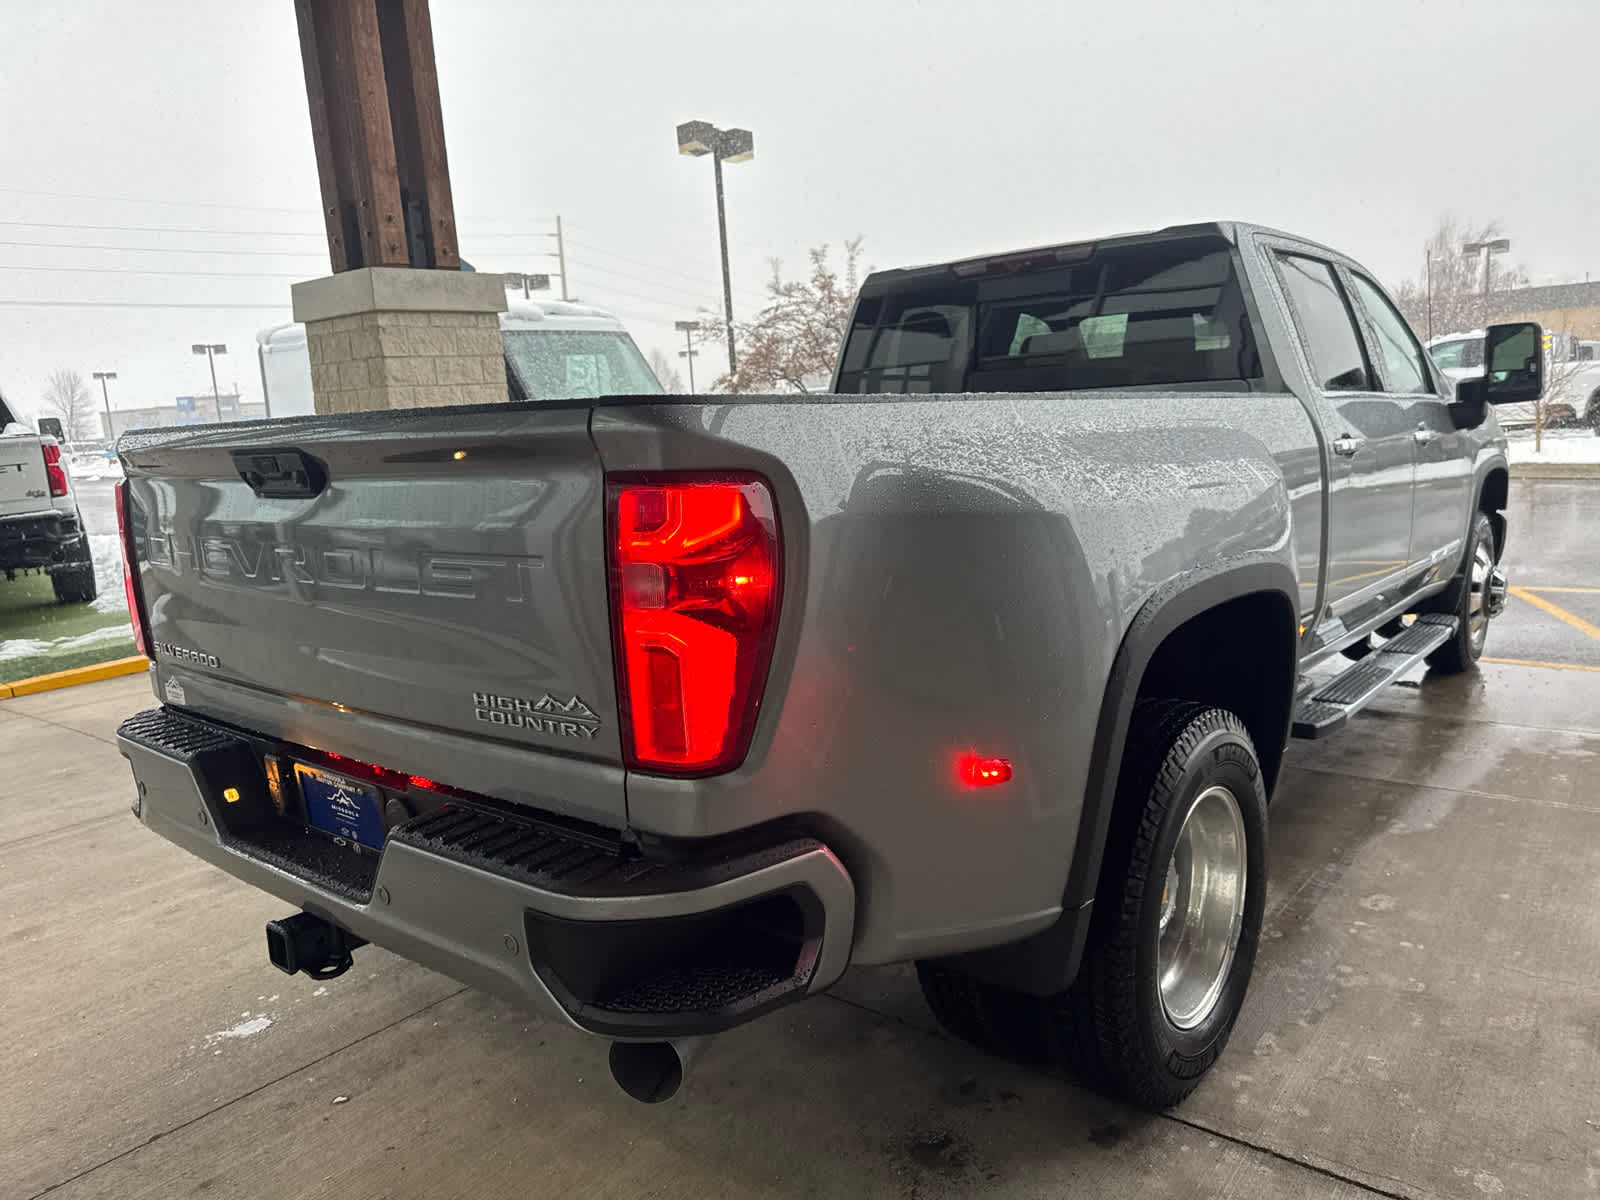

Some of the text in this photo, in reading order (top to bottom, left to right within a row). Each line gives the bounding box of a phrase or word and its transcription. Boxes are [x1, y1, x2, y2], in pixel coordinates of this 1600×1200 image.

[146, 534, 545, 603] CHEVROLET
[154, 640, 220, 668] SILVERADO
[473, 692, 531, 712] HIGH
[475, 708, 600, 740] COUNTRY
